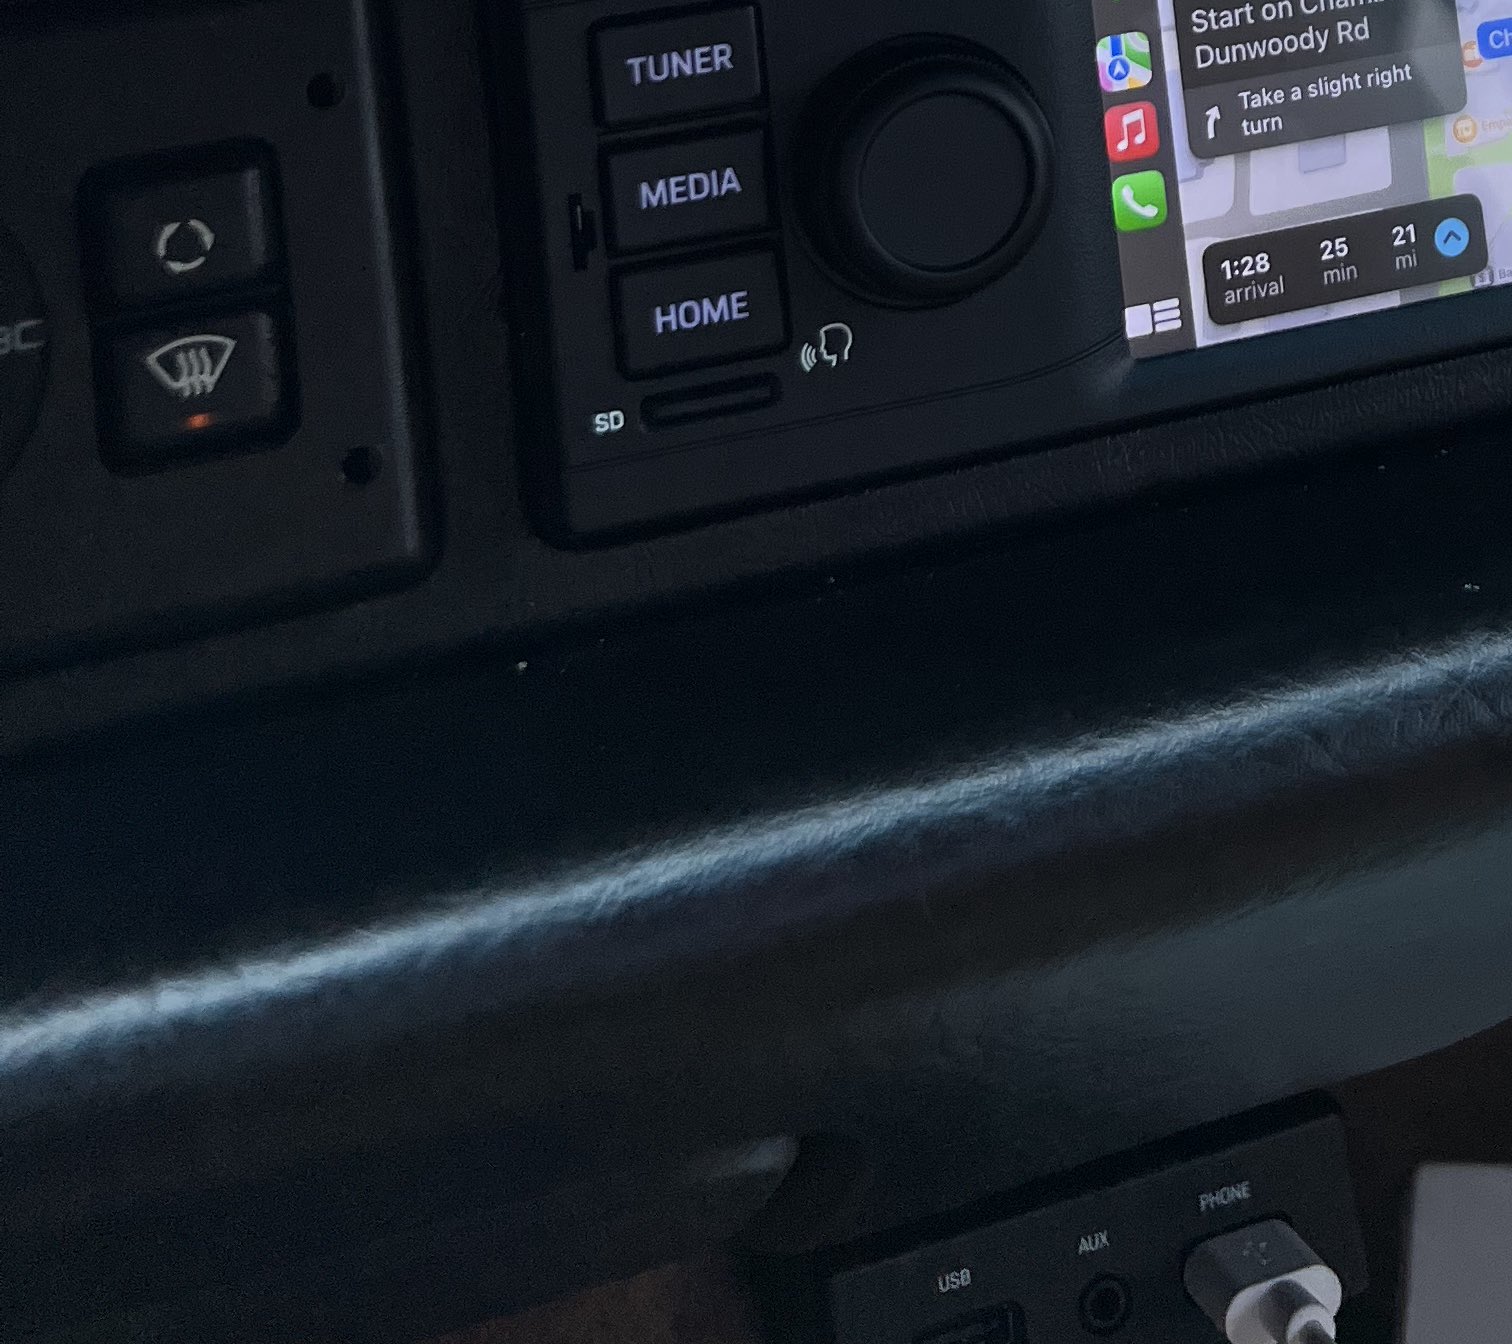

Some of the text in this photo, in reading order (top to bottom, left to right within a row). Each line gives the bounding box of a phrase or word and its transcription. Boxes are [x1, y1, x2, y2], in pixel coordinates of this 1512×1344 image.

[1191, 2, 1255, 33] Start
[1195, 16, 1371, 69] Dunwoody Rd
[625, 43, 734, 85] TUNER
[1238, 64, 1412, 110] Take a slight right
[1241, 115, 1283, 137] turn
[638, 167, 743, 210] MEDIA
[1391, 223, 1418, 247] 21
[1319, 237, 1350, 261] 25
[1395, 248, 1418, 270] mi
[1220, 253, 1271, 280] 1:28
[1323, 262, 1359, 286] min
[1224, 275, 1285, 305] arrival
[654, 290, 750, 335] HOME
[595, 411, 625, 433] SD
[1199, 1181, 1252, 1211] PHONE
[1077, 1231, 1110, 1255] AUX
[937, 1268, 972, 1293] USB
